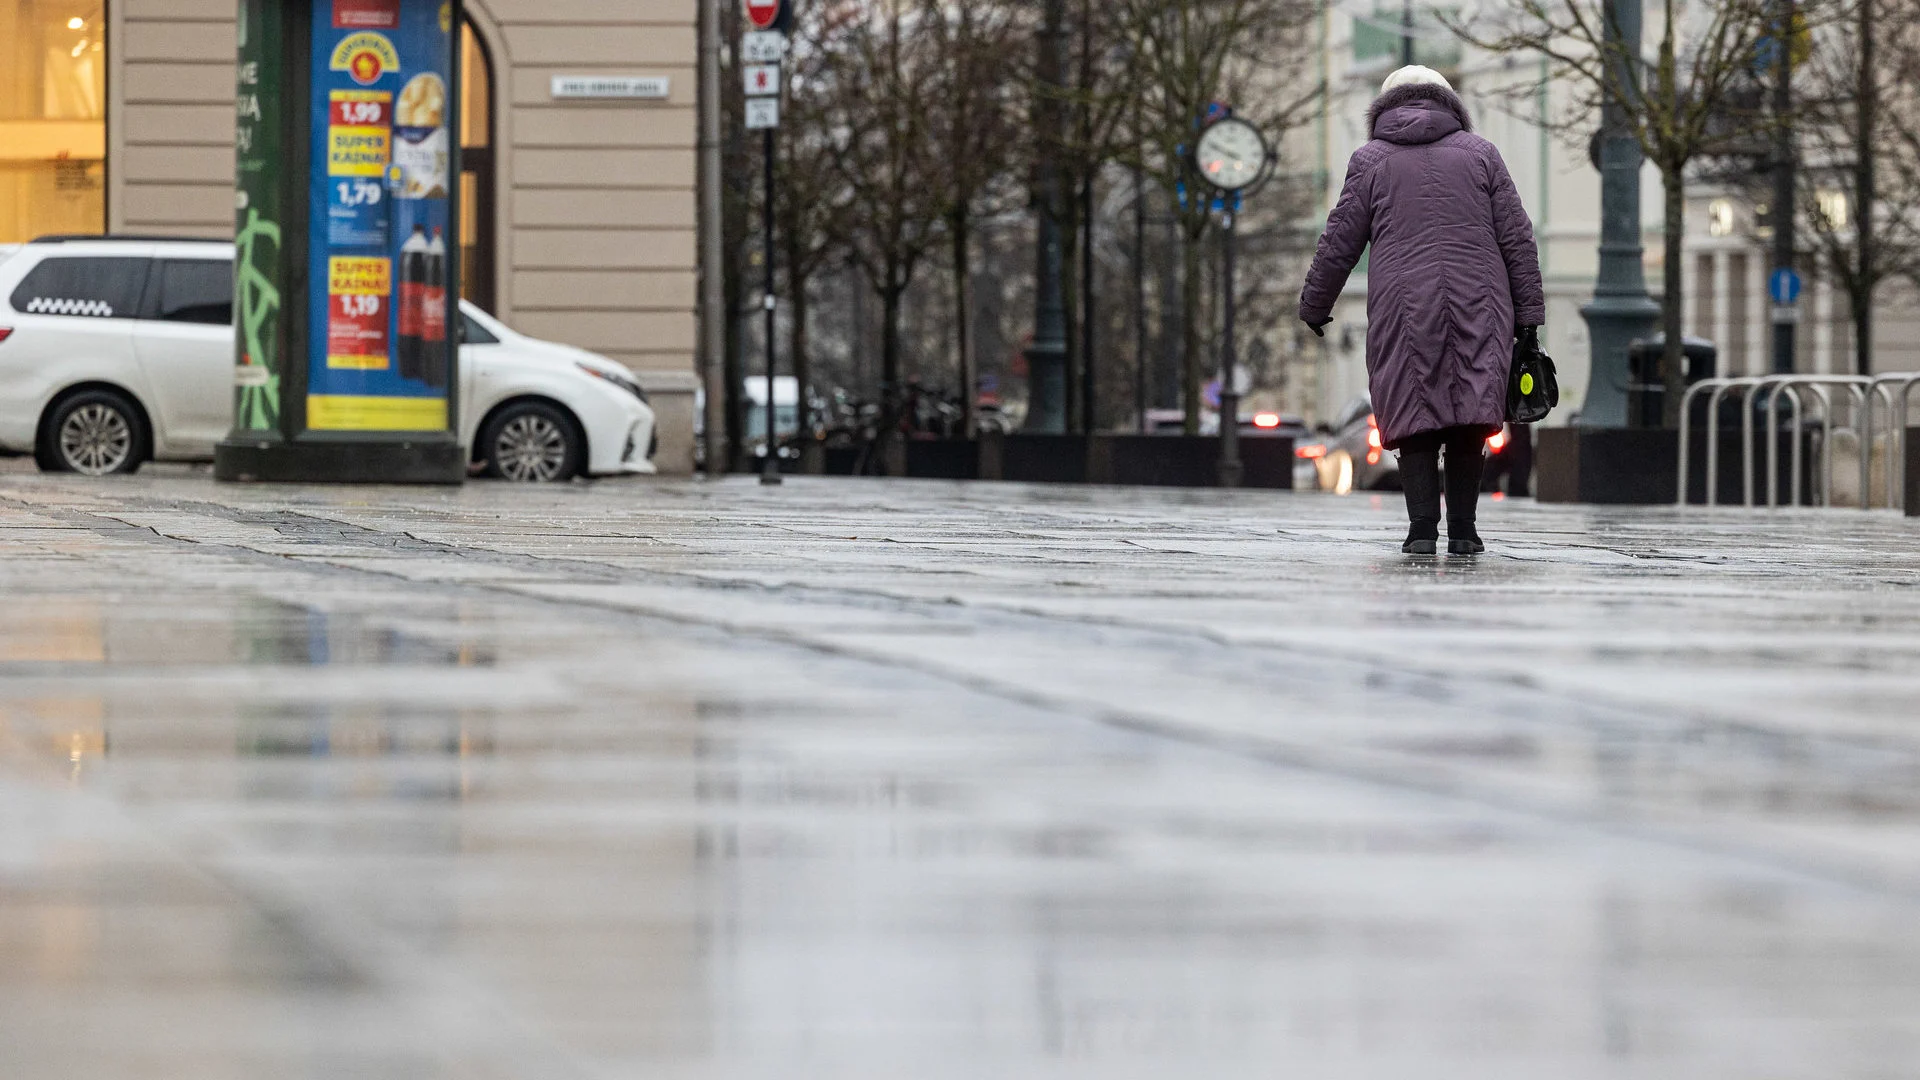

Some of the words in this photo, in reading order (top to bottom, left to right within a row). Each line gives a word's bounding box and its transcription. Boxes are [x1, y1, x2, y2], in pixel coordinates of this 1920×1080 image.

[340, 102, 382, 124] 1,99
[334, 135, 385, 148] SUPER
[336, 182, 382, 205] 1,79
[334, 262, 384, 274] SUPER
[340, 295, 380, 318] 1,19
